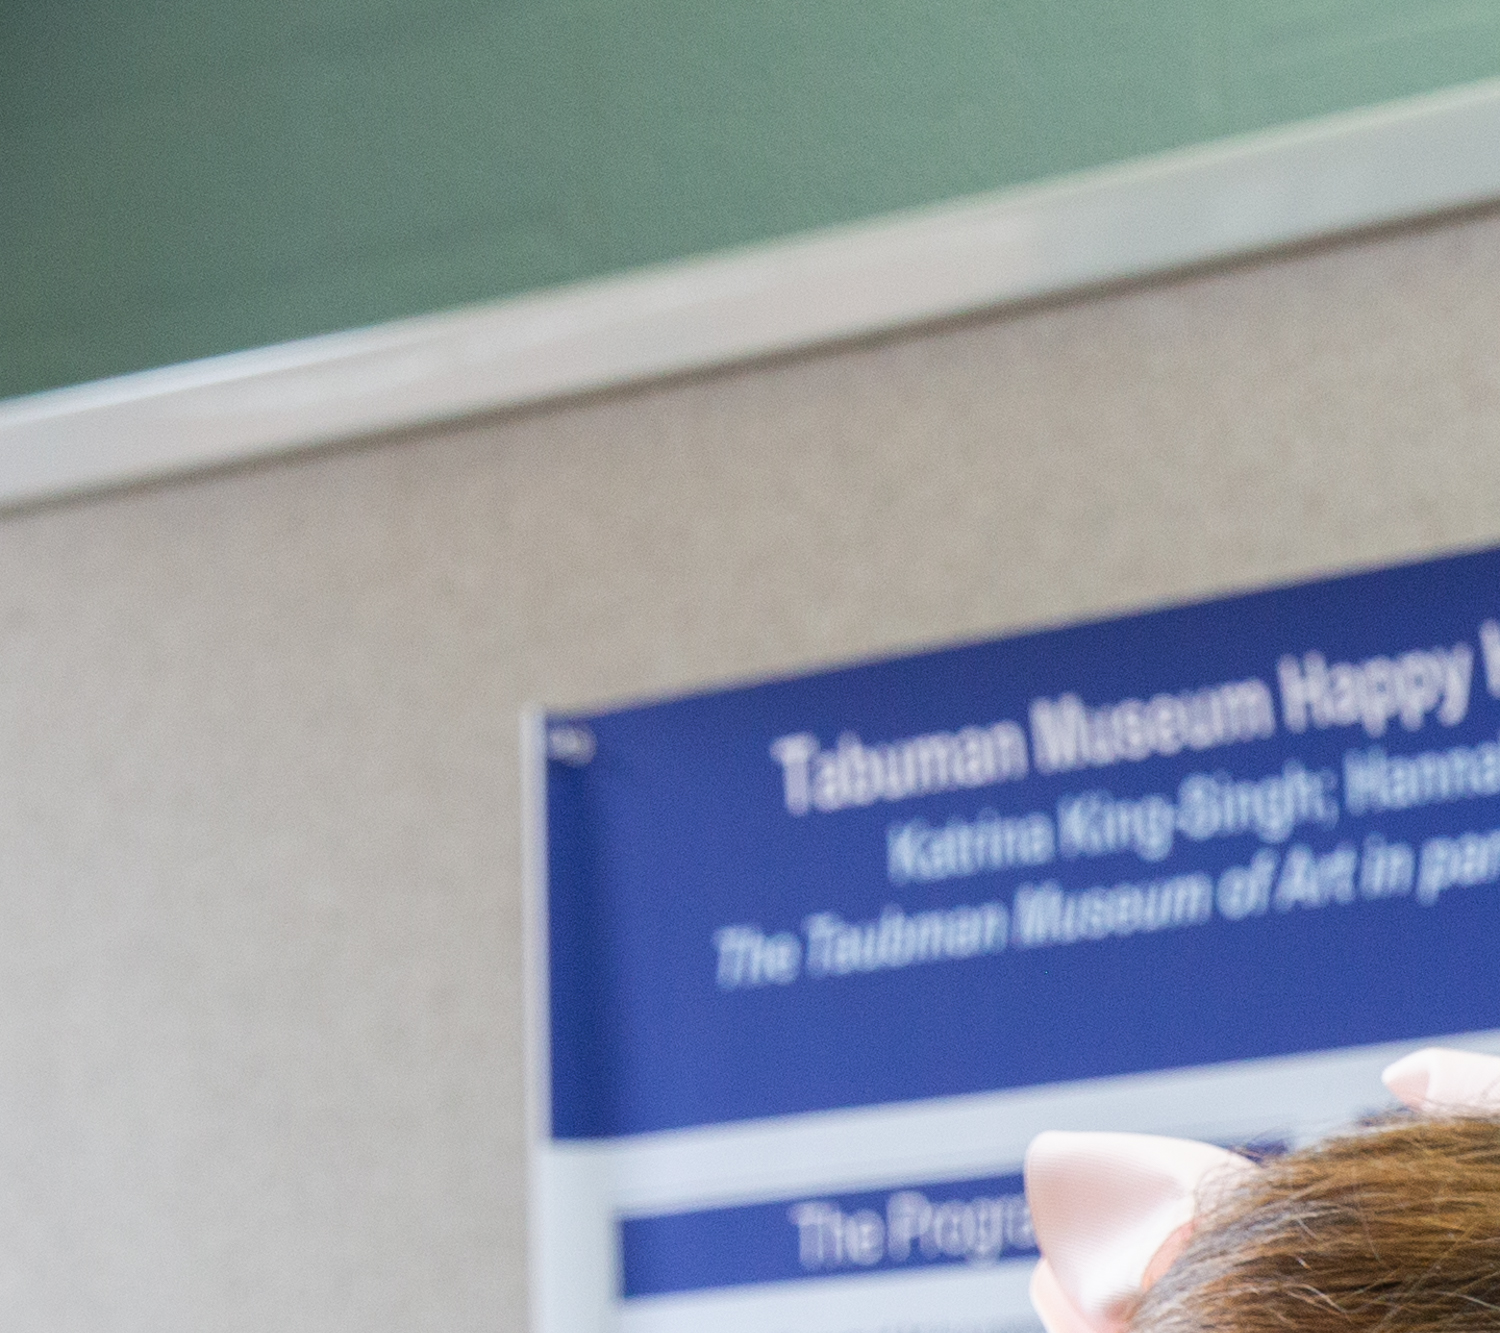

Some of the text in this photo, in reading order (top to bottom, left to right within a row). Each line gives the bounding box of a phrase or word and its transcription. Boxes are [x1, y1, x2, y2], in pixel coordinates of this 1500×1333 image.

[1030, 677, 1275, 774] Museum
[1277, 642, 1475, 736] Happy
[887, 808, 1056, 883] Katrina
[714, 925, 801, 990] The
[804, 904, 1010, 978] Taubman
[1012, 872, 1214, 950] Museum
[1216, 849, 1280, 920] of
[1275, 842, 1357, 912] Art
[1360, 834, 1414, 899] in
[785, 1201, 885, 1268] The
